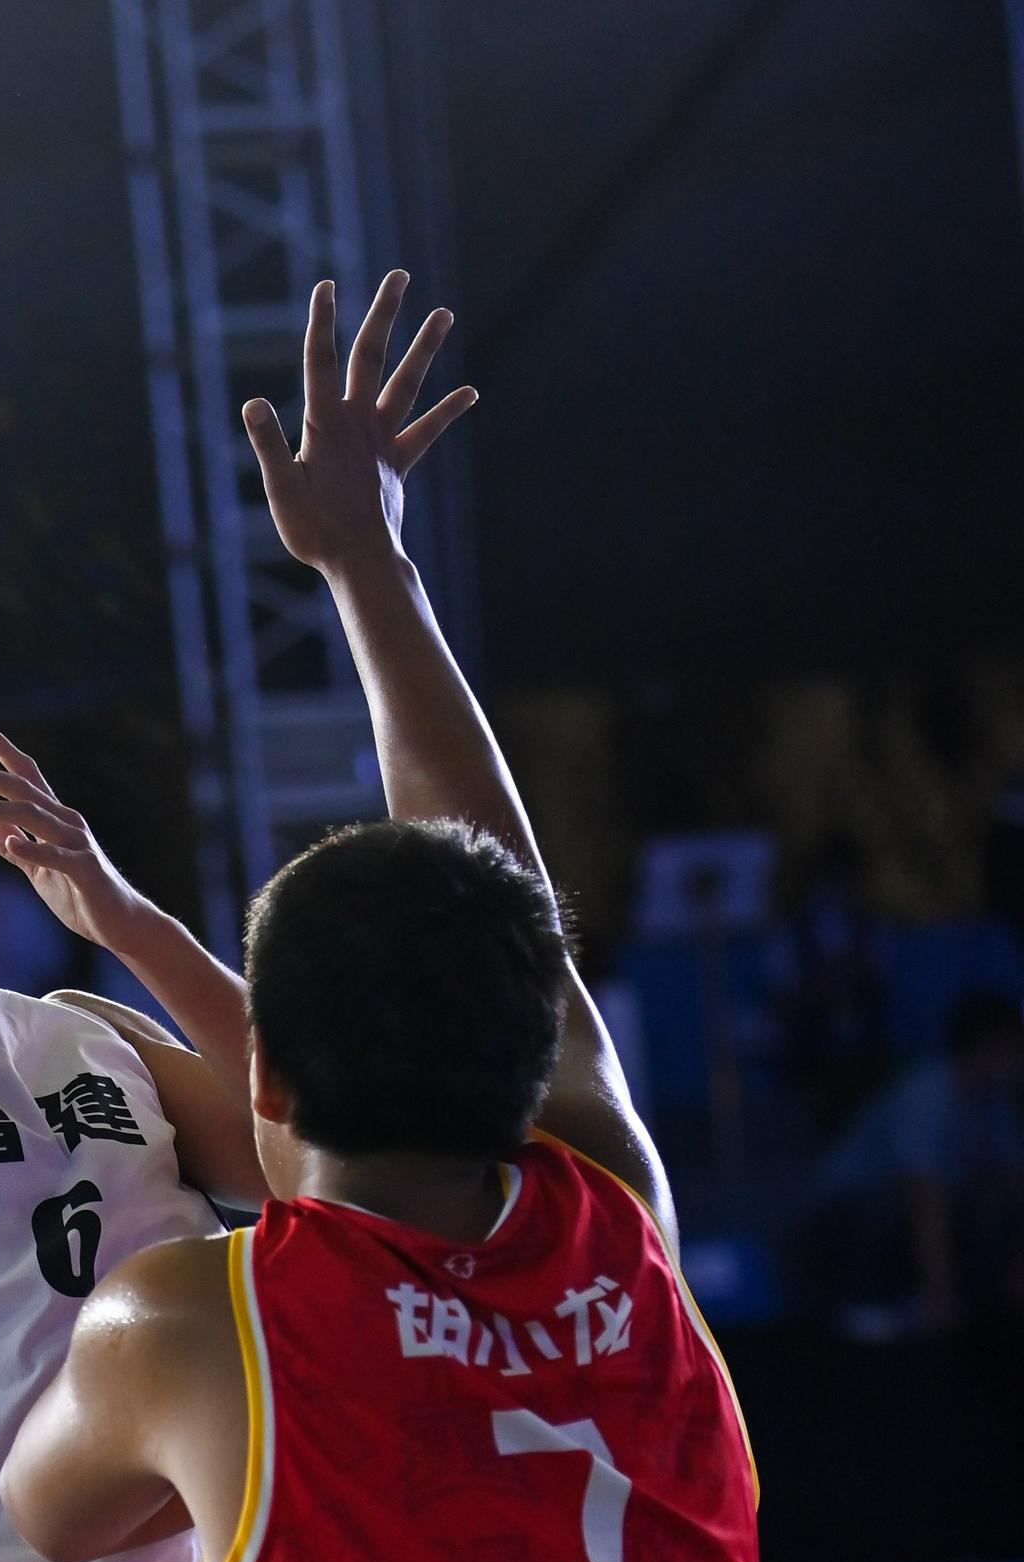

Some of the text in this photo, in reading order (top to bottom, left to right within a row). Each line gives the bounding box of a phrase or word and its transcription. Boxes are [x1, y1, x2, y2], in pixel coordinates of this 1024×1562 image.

[31, 1179, 103, 1298] 6
[384, 1275, 633, 1376] 胡小龙
